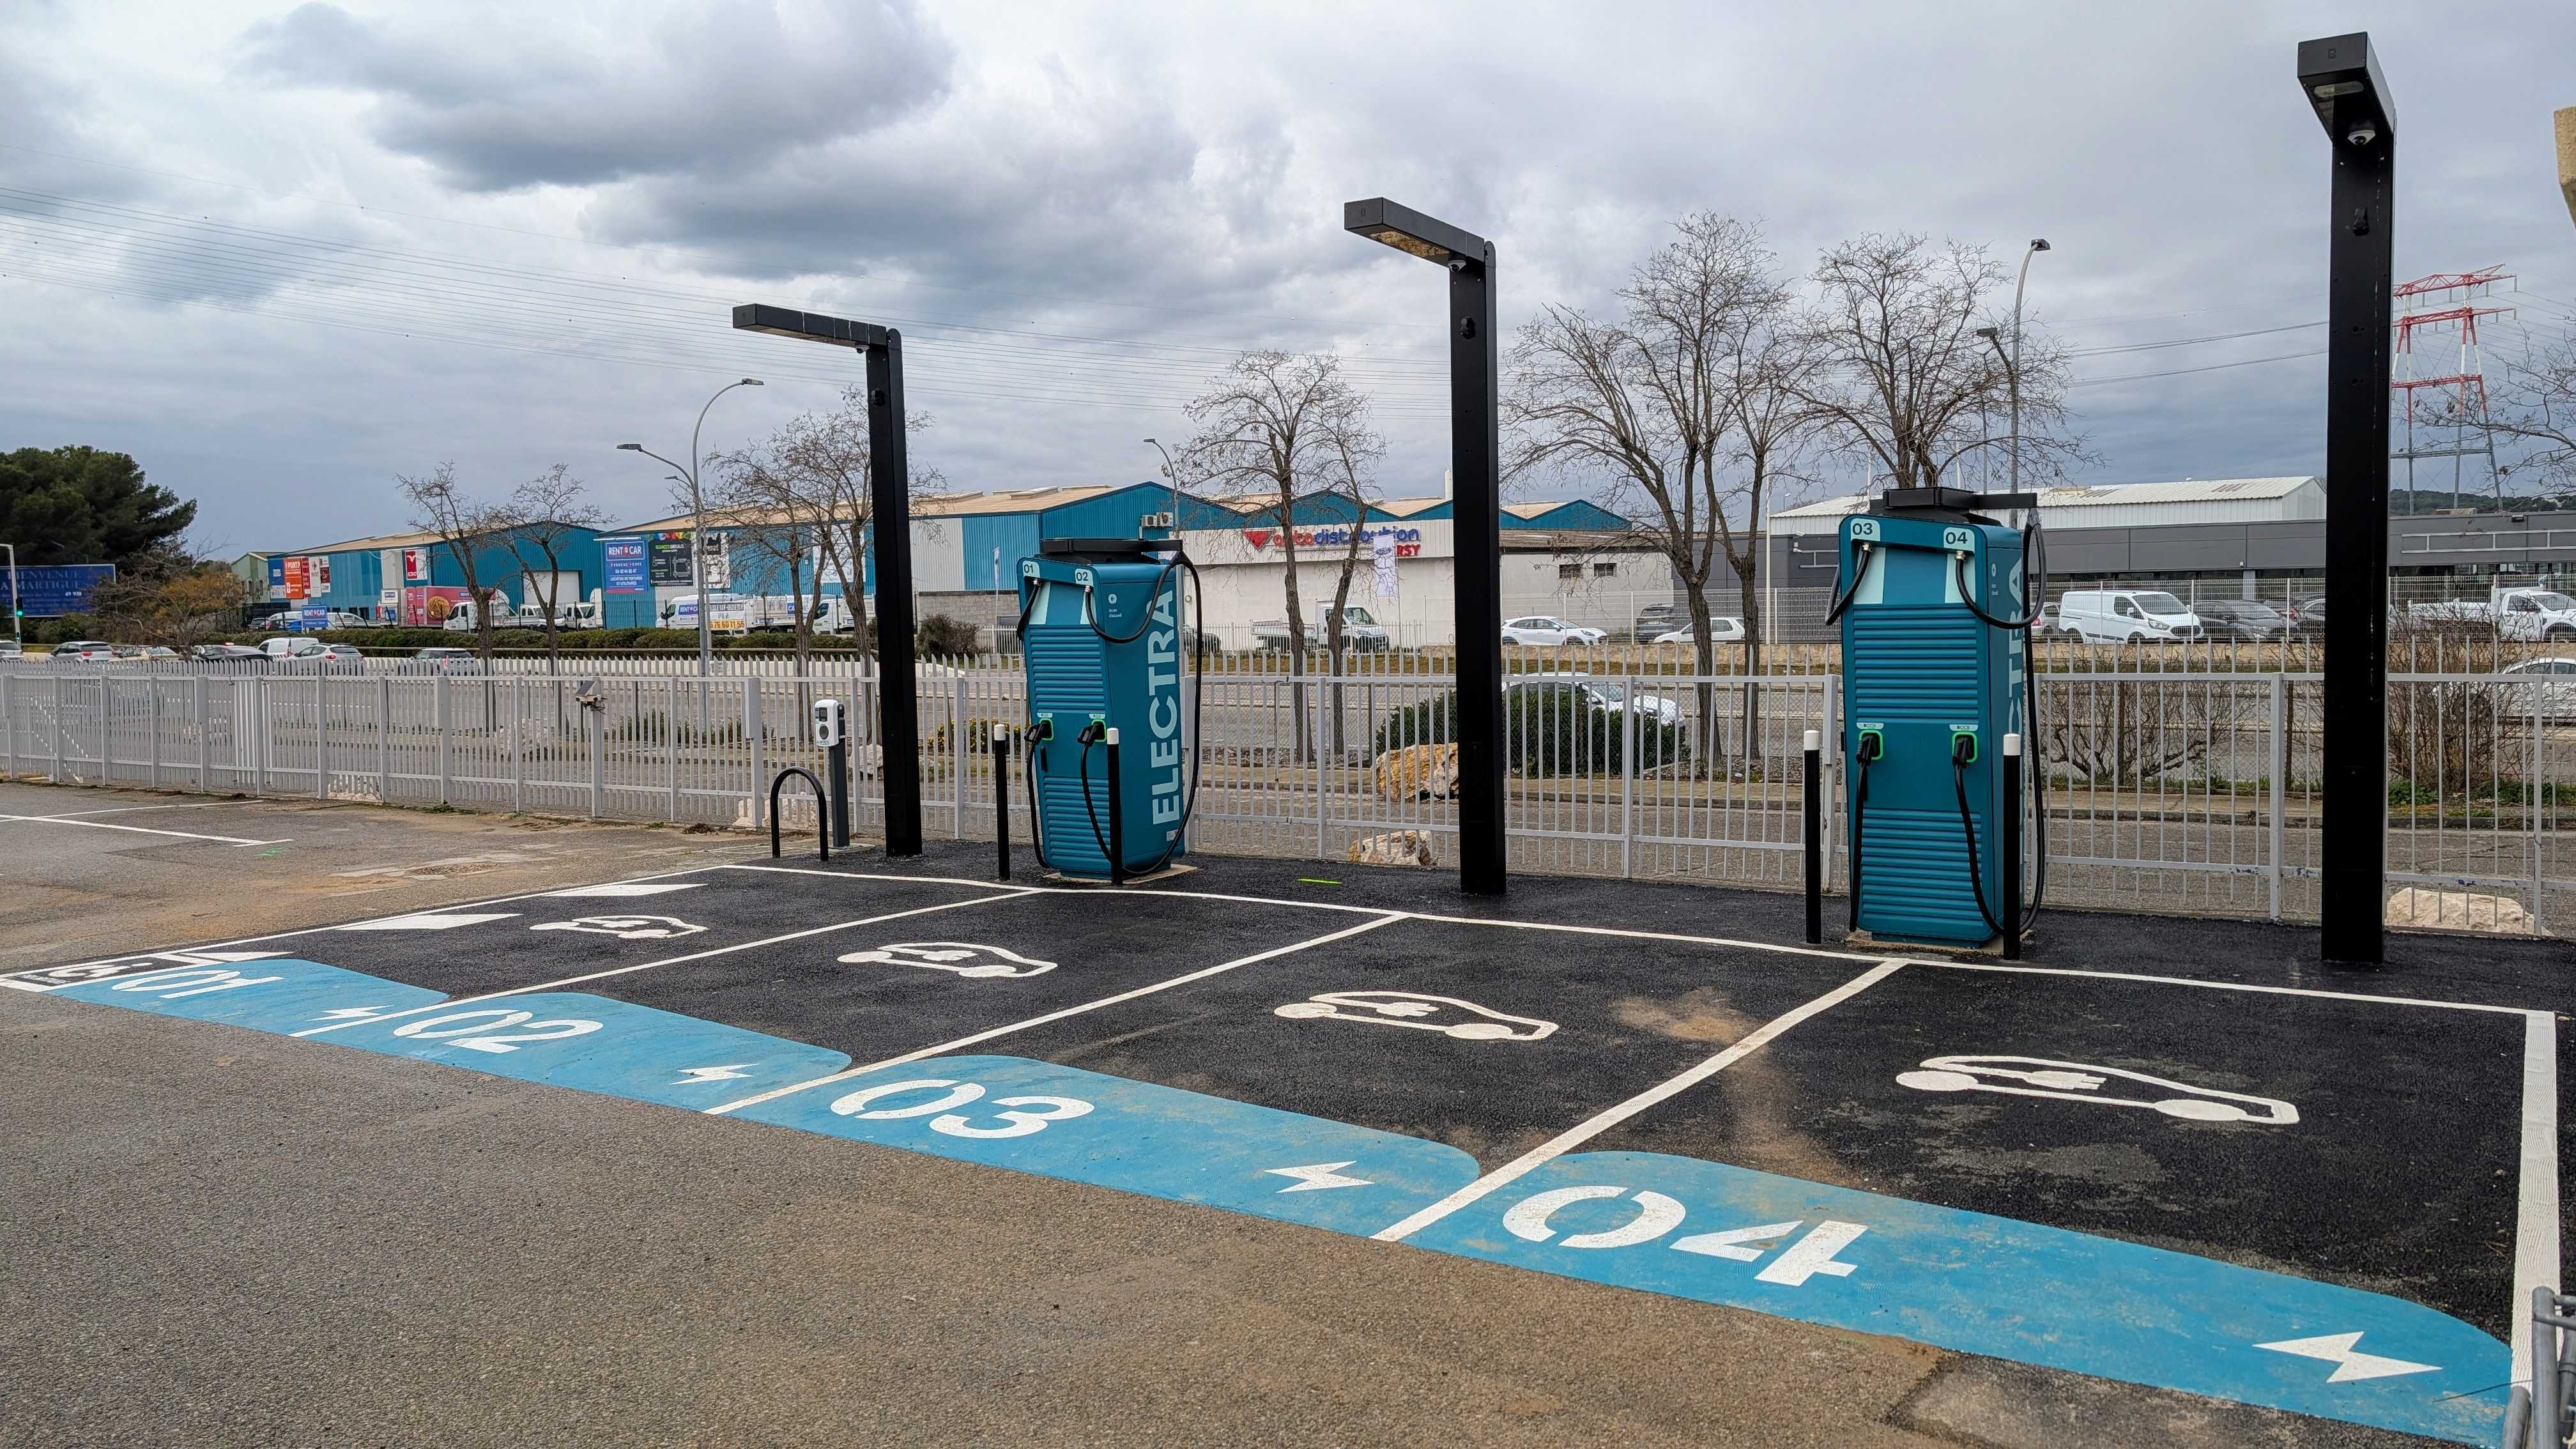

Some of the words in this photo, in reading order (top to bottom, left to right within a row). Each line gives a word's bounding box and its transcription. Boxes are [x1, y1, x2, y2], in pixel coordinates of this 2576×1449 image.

[1852, 523, 1873, 535] 03
[1945, 532, 1968, 544] 04
[608, 546, 624, 555] RENT
[629, 546, 642, 555] CAR
[1023, 564, 1034, 574] 01
[1076, 572, 1089, 581] 02
[1146, 590, 1180, 825] ELECTRA
[112, 970, 285, 999] 01
[394, 1009, 603, 1054] 02
[831, 1080, 1094, 1138] 03
[1503, 1185, 1868, 1287] 04
